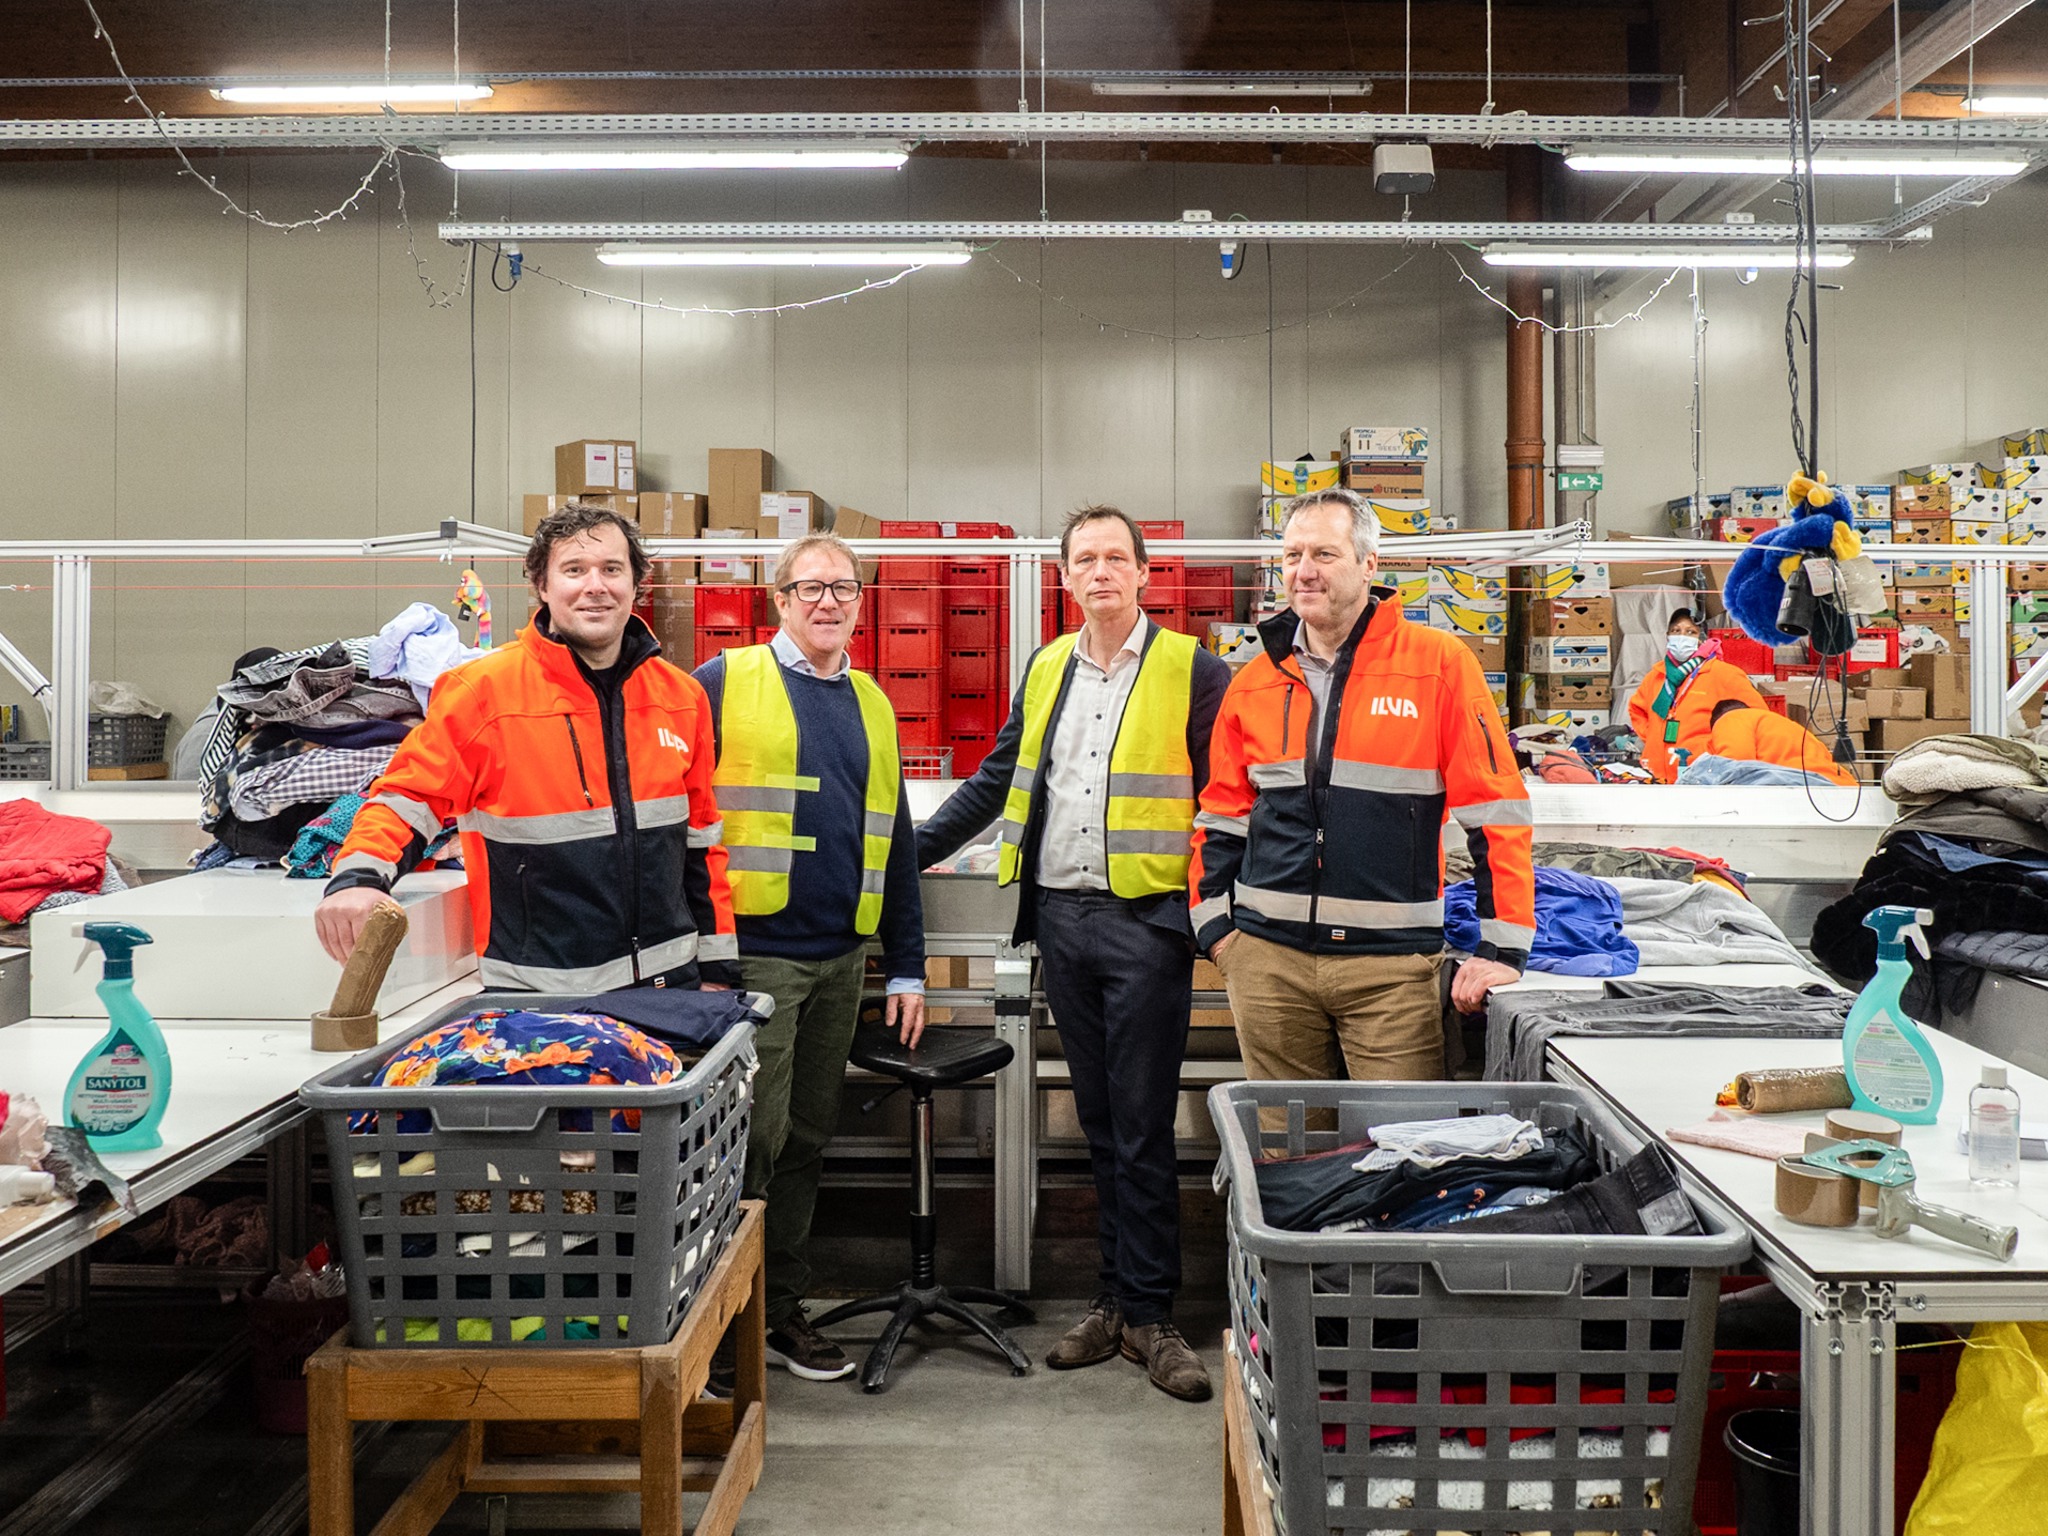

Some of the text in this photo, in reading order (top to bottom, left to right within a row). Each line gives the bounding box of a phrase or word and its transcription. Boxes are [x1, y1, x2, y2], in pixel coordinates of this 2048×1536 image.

[1370, 696, 1419, 720] ILVA
[657, 727, 690, 753] ILA
[88, 1077, 144, 1089] SANYTOL
